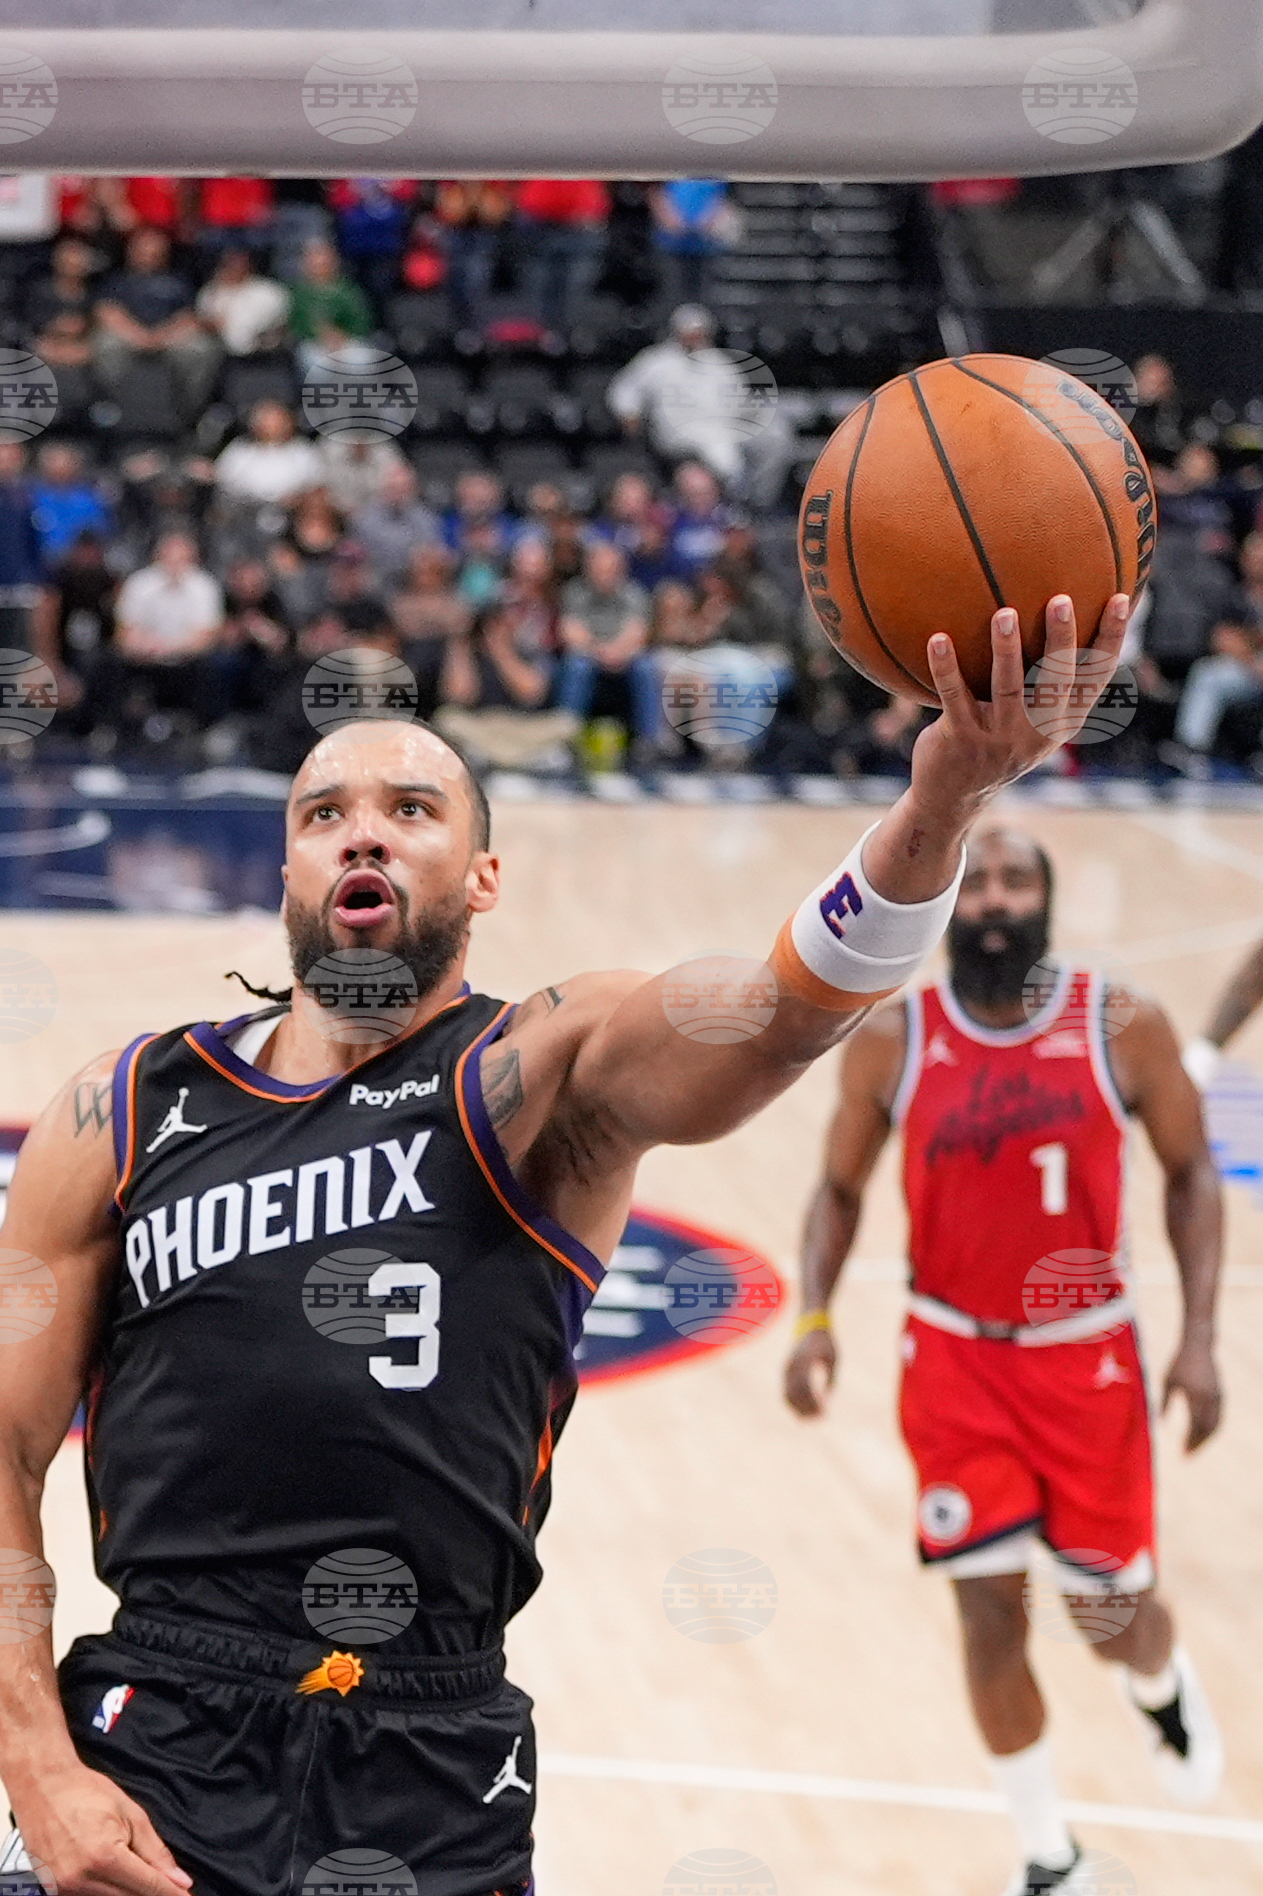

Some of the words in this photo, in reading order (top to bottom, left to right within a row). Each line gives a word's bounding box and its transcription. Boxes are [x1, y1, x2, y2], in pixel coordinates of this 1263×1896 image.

[349, 1075, 440, 1109] PayPal
[126, 1130, 436, 1308] PHOENIX
[1030, 1142, 1070, 1216] 1
[368, 1263, 441, 1389] 3
